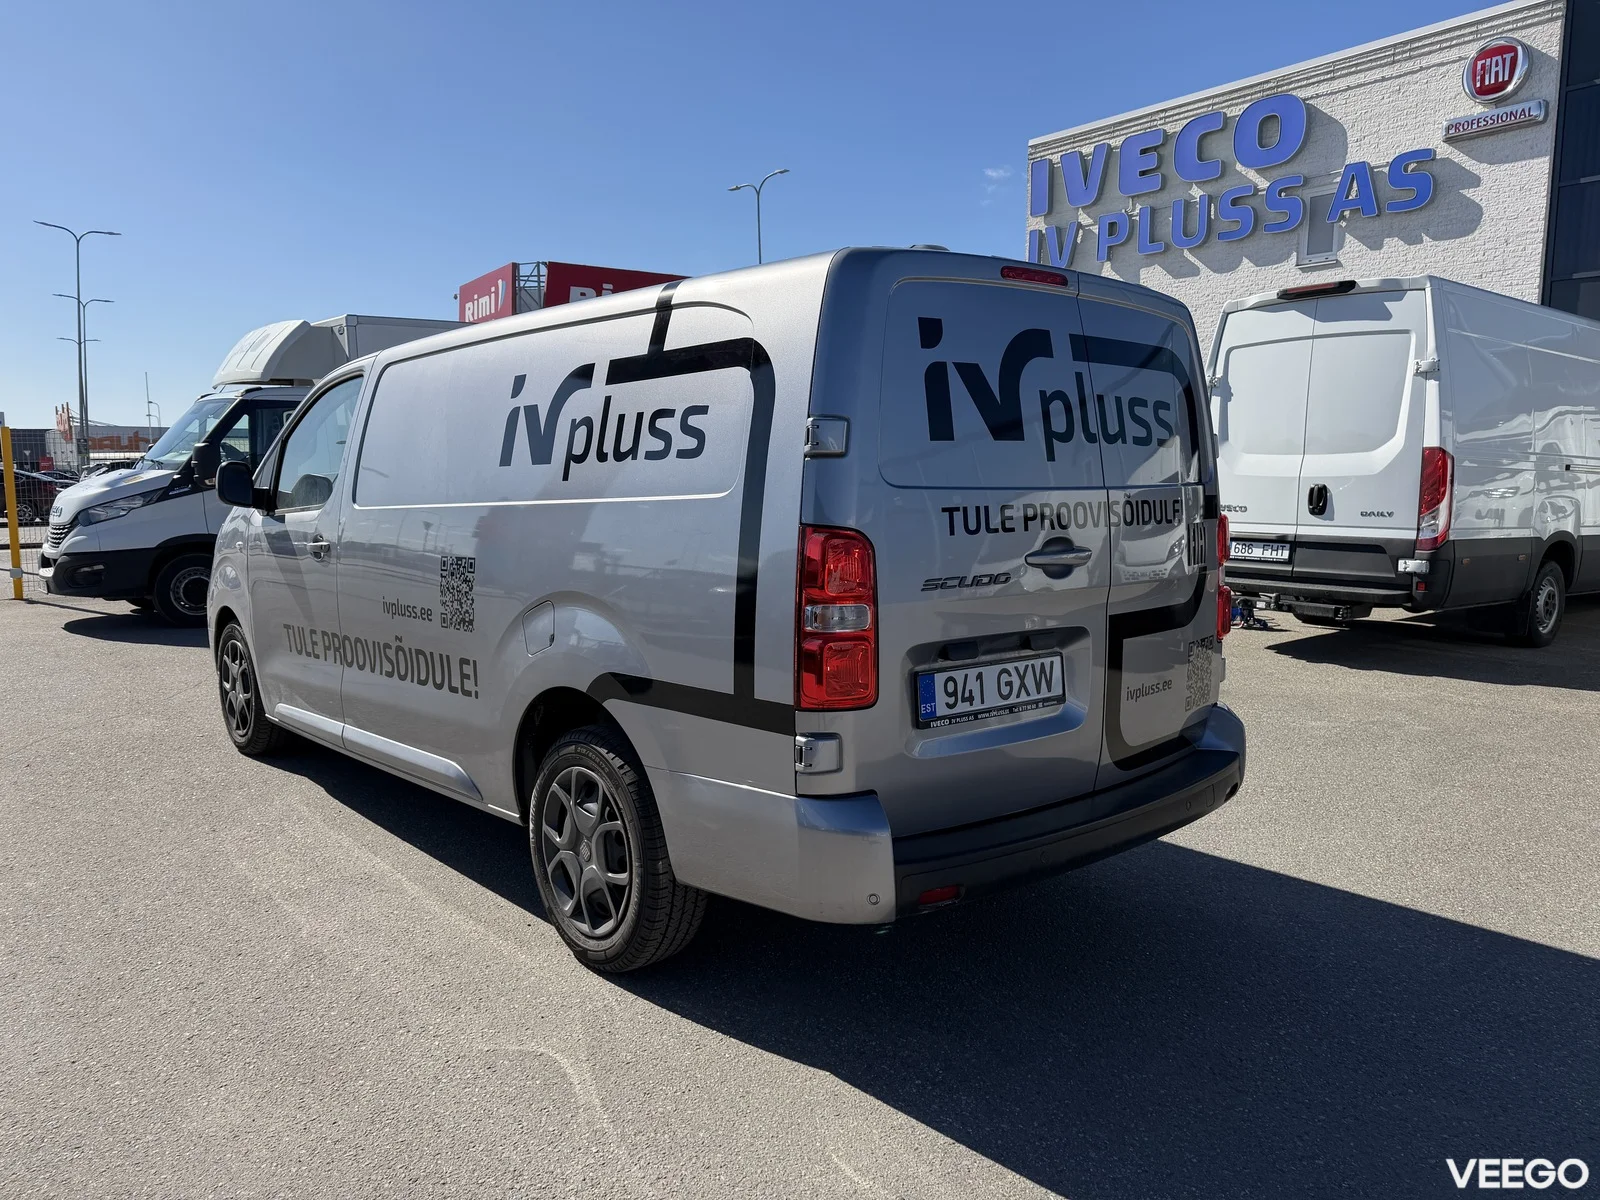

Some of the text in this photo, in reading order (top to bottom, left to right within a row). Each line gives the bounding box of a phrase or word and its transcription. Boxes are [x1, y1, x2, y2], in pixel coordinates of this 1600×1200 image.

[1476, 53, 1515, 88] FIAT
[1447, 107, 1534, 135] PROFESSIONAL
[1029, 93, 1307, 217] IVECO
[1028, 147, 1437, 268] IV PLUSS AS
[941, 504, 1016, 537] TULE
[1220, 504, 1248, 513] VECO
[1360, 510, 1395, 518] DAILY
[1234, 542, 1287, 557] 686 FHT
[921, 572, 1012, 592] SCUDO
[382, 596, 433, 622] ivpluss.ee
[283, 623, 479, 699] TULE PROOVISÕIDULE!
[943, 660, 1055, 710] 941 GXW
[1126, 678, 1173, 703] ivpluss.ee
[921, 702, 936, 714] EST
[930, 719, 950, 728] IVECO
